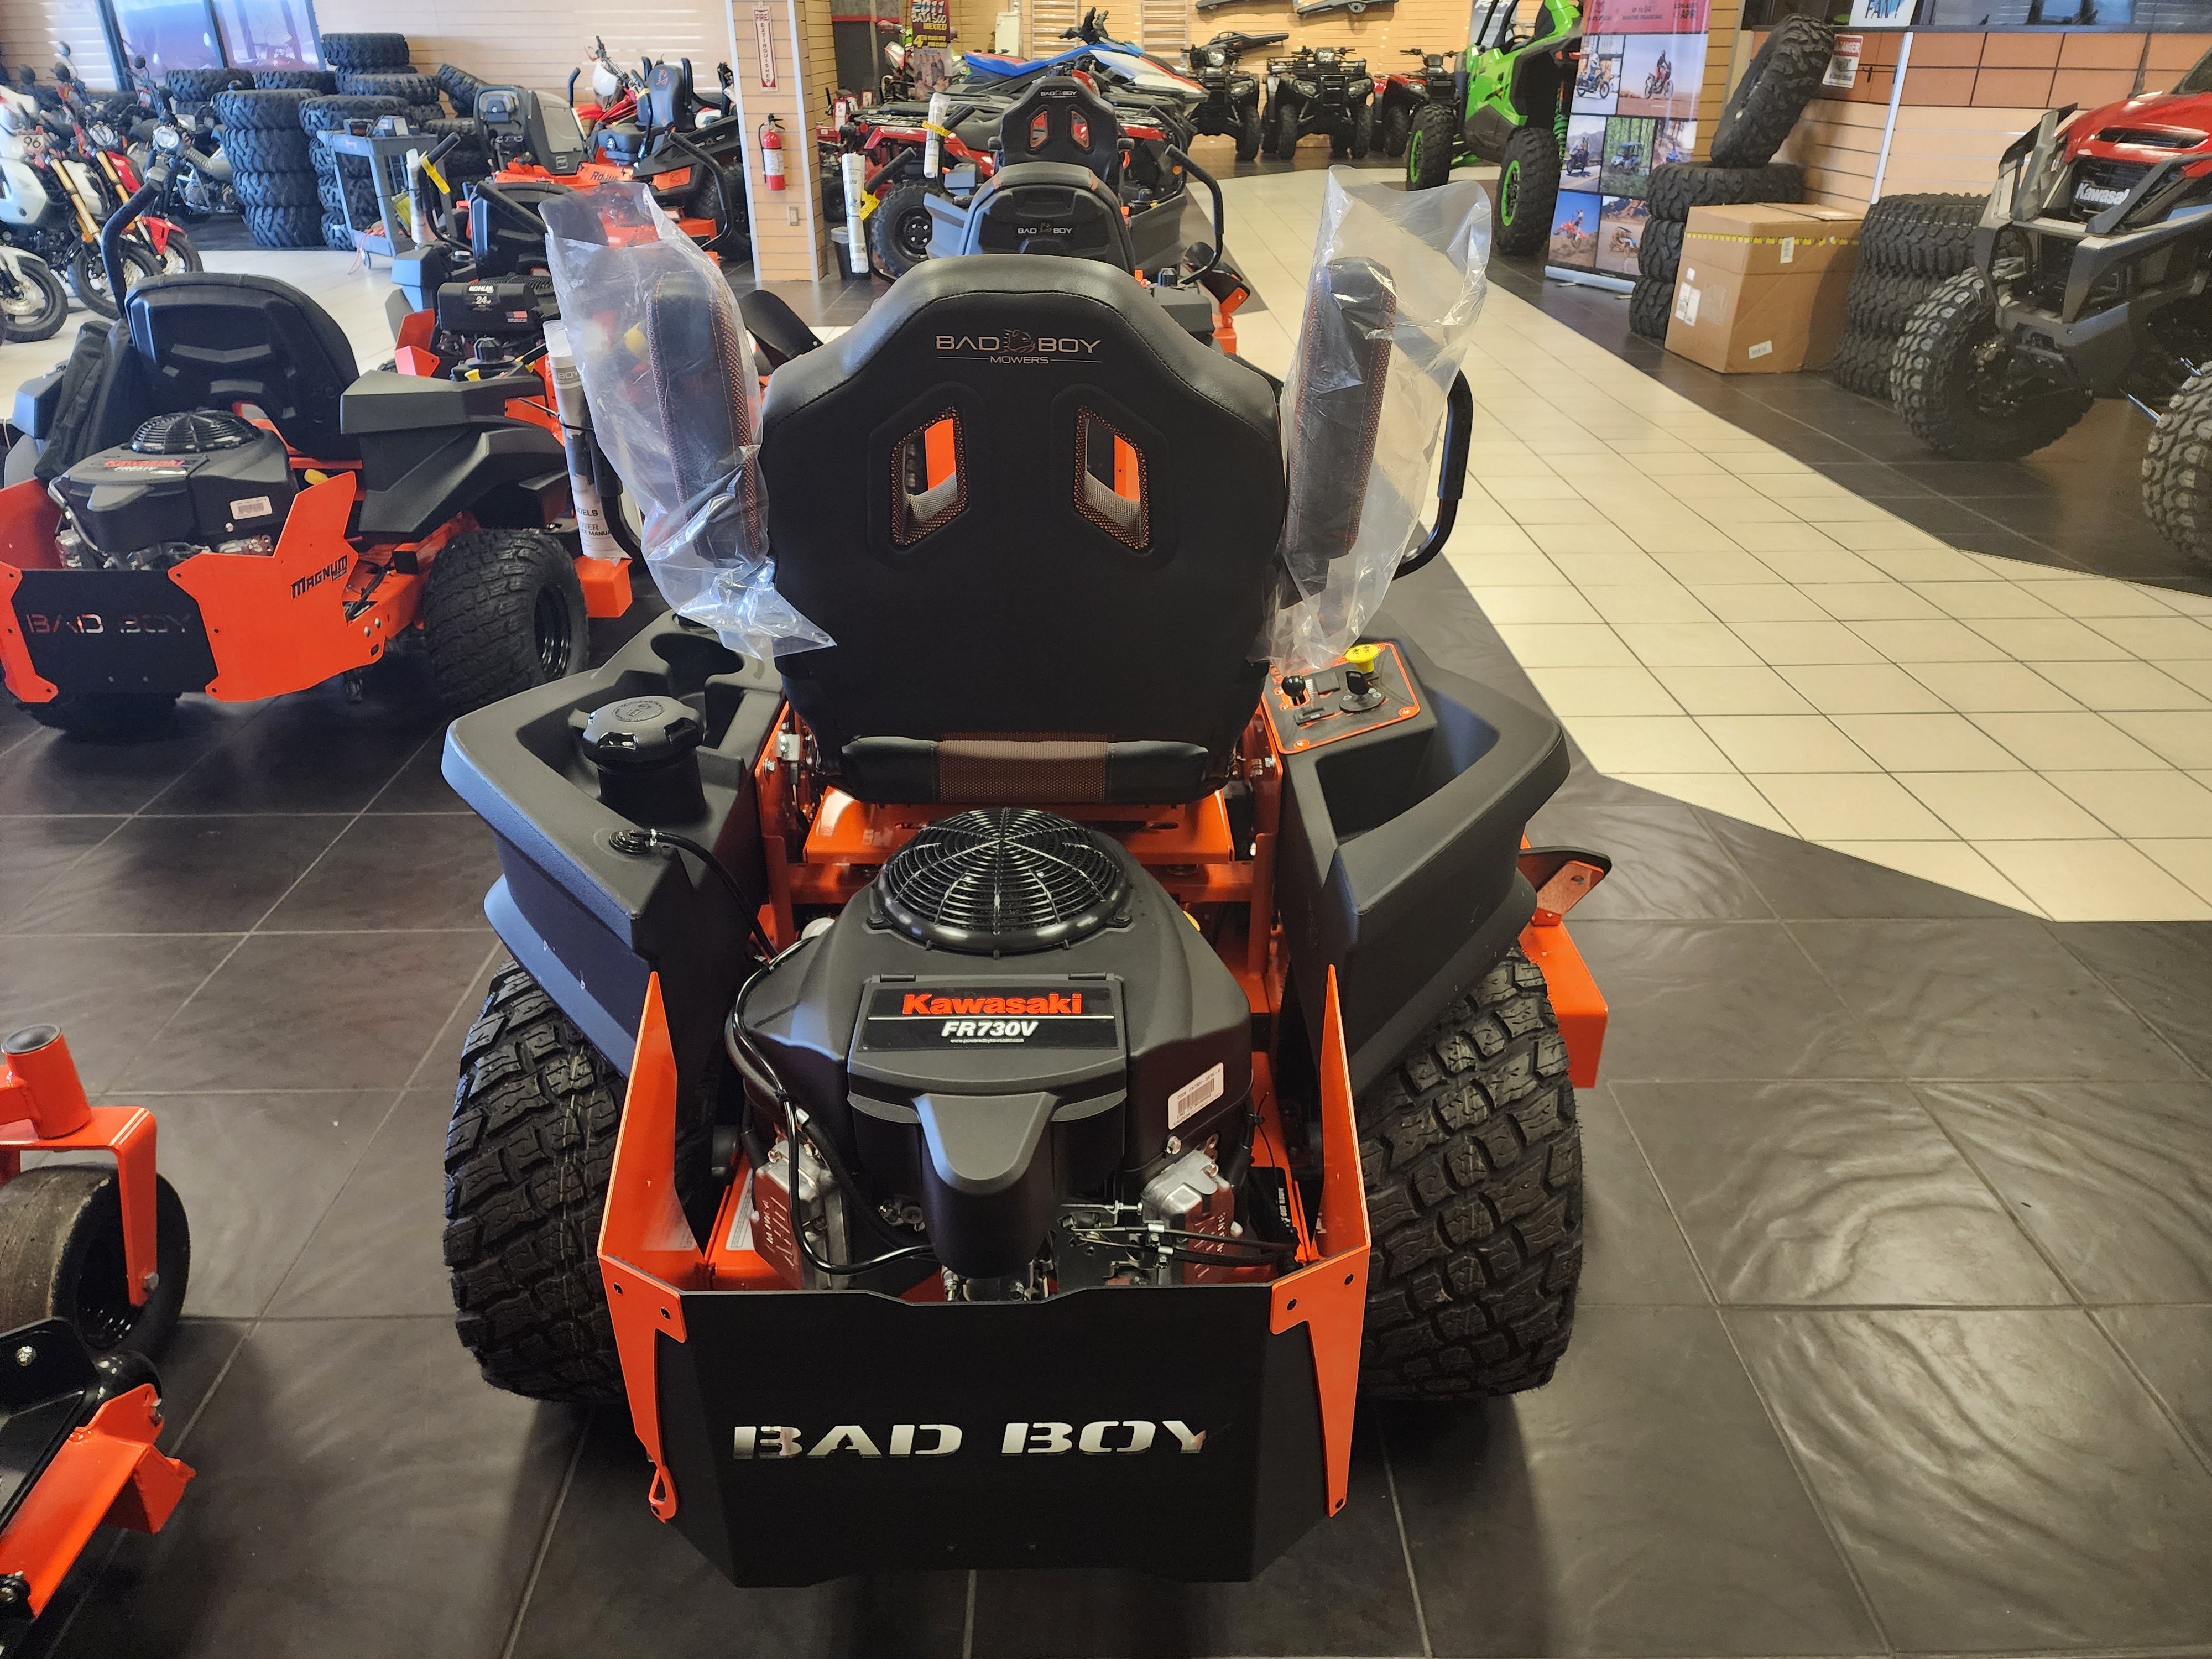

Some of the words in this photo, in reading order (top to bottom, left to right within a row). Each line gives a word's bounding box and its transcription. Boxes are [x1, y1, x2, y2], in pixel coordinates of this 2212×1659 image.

[760, 23, 770, 83] EXTINGUISHER
[23, 136, 41, 149] 96
[476, 296, 487, 304] 24
[935, 335, 1000, 351] BAD
[1037, 337, 1102, 353] BOY
[990, 356, 1050, 364] MOWERS
[291, 554, 348, 600] MAGNUM
[902, 993, 1083, 1015] Kawasaki
[941, 1021, 1039, 1037] FR730V
[732, 1425, 963, 1459] BAD
[1000, 1420, 1207, 1455] BOY
